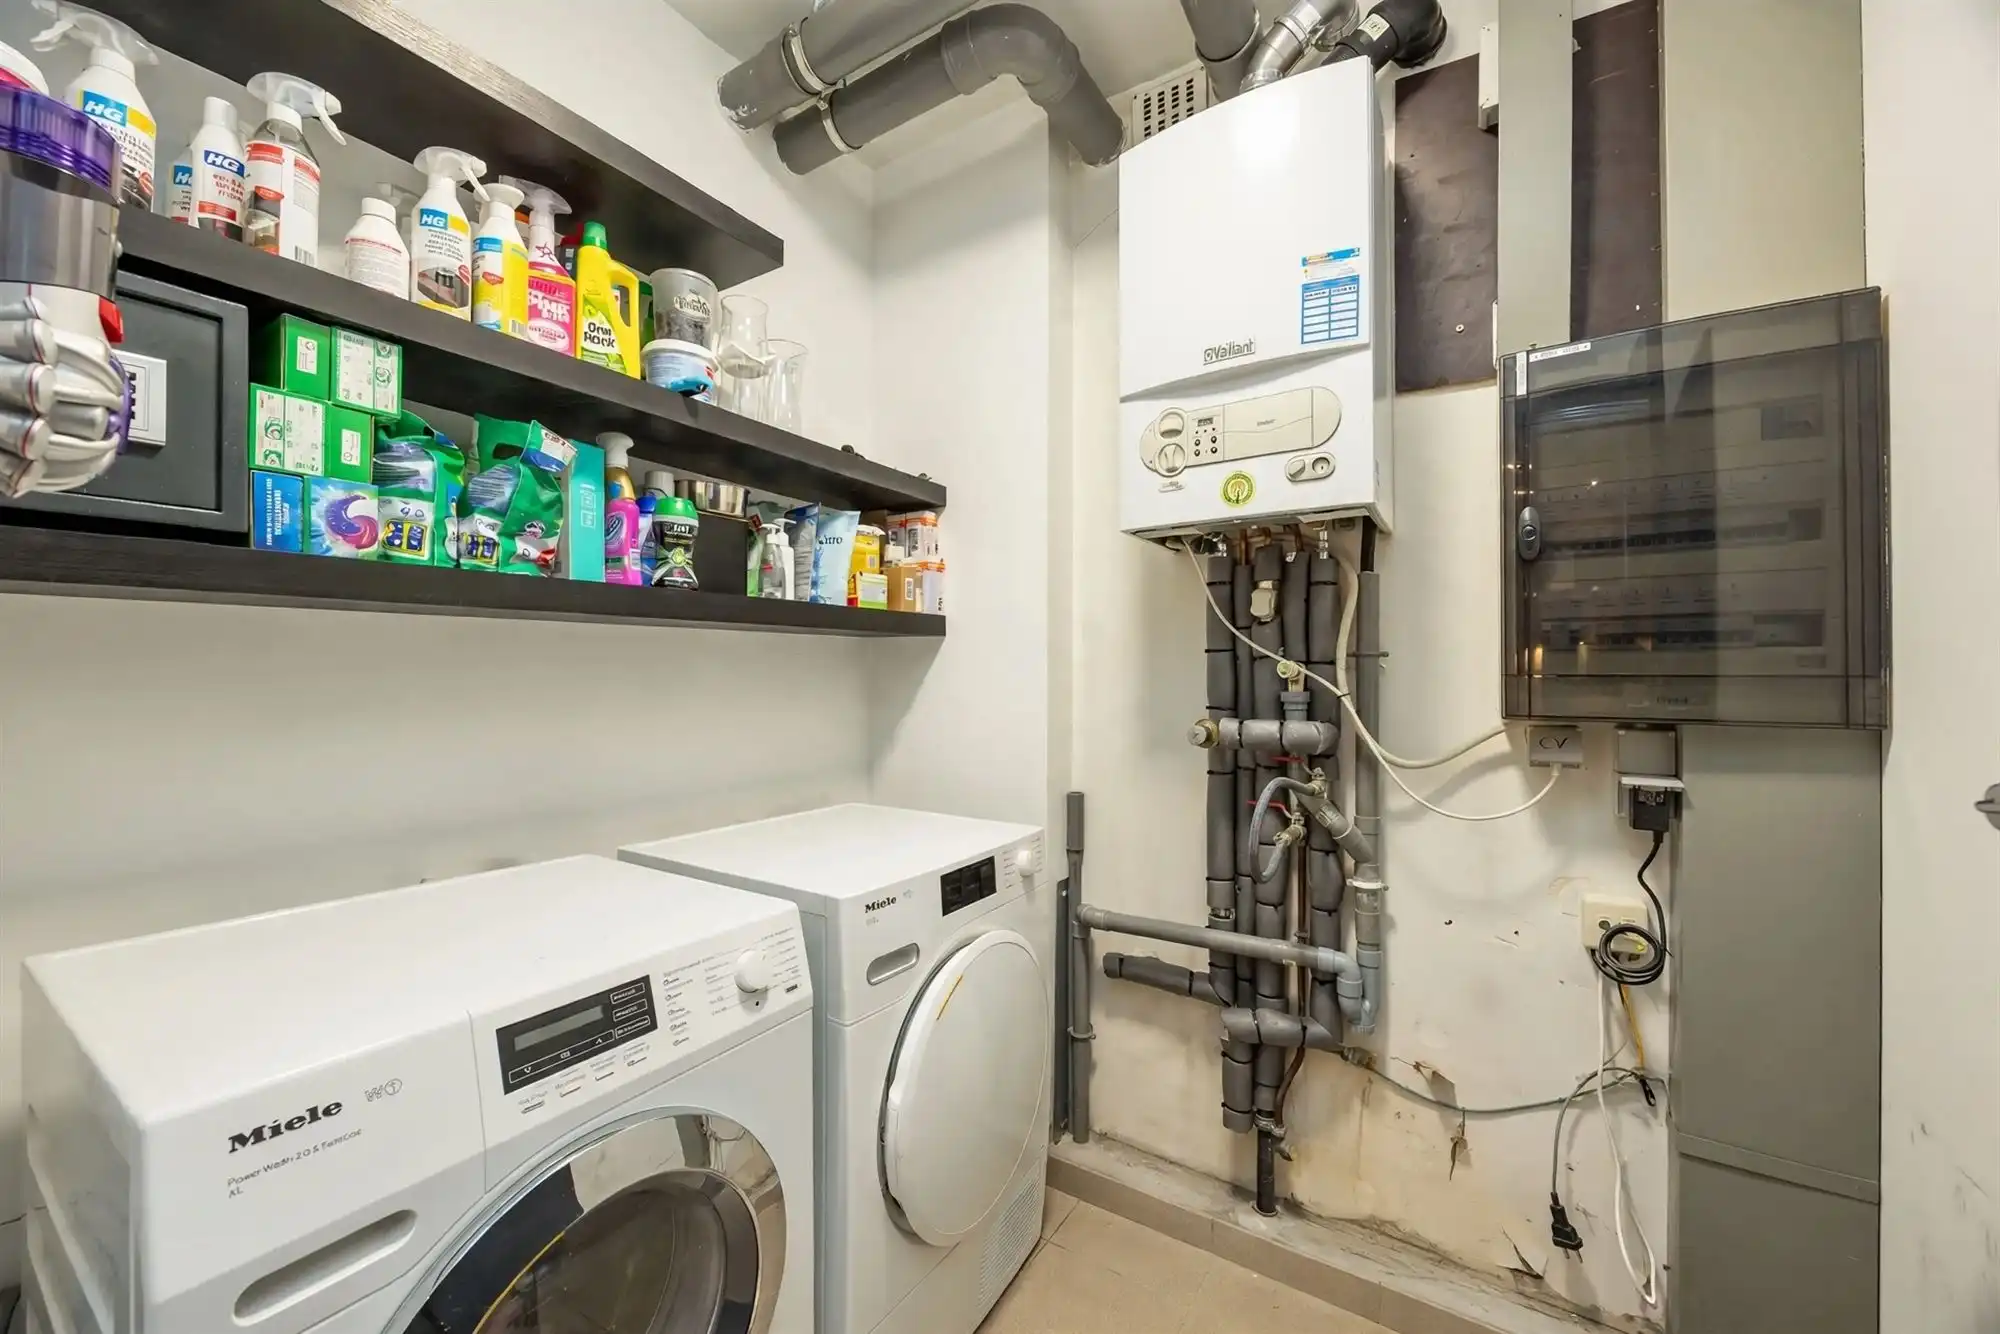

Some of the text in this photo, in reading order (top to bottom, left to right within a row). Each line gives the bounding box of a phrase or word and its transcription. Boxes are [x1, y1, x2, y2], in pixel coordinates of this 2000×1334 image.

[84, 100, 124, 122] HG
[207, 153, 240, 172] HG
[175, 171, 192, 185] H
[421, 214, 445, 227] HG
[1214, 338, 1254, 359] Vaillant
[1539, 736, 1568, 749] CV
[864, 897, 897, 914] Miele
[228, 1101, 343, 1154] Miele
